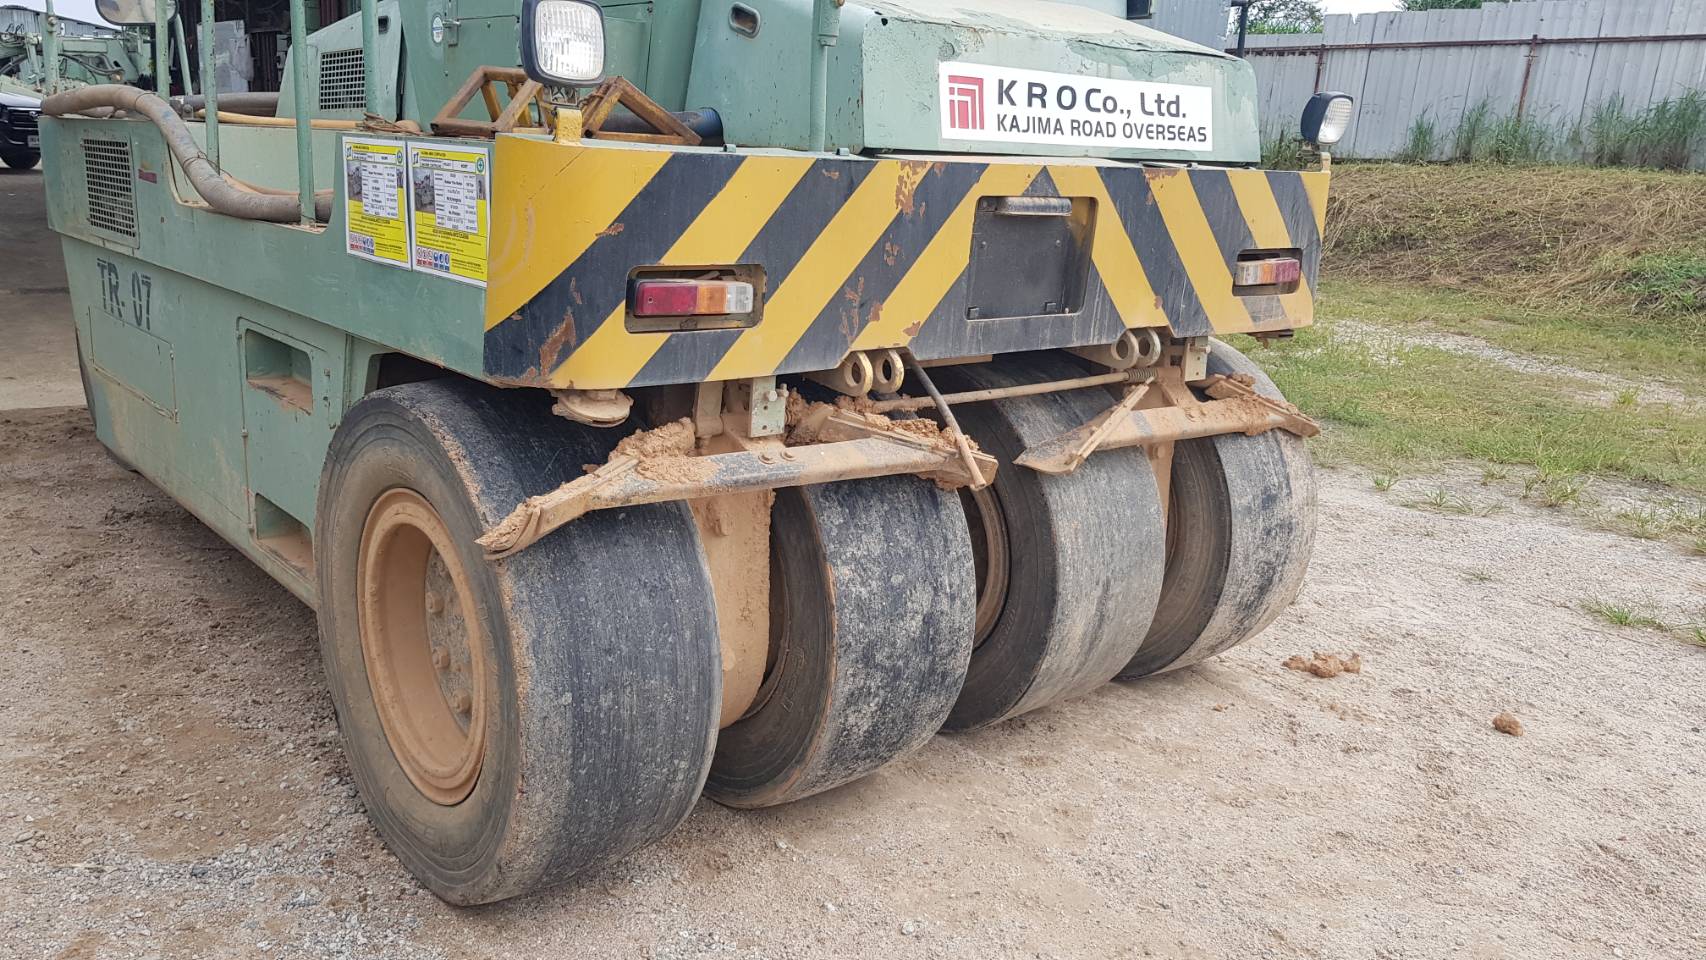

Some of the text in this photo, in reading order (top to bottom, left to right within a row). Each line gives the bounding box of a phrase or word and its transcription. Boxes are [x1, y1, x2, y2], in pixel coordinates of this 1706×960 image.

[1140, 91, 1186, 118] Ltd.
[997, 113, 1207, 142] KAJIMA ROAD OVERSEAS
